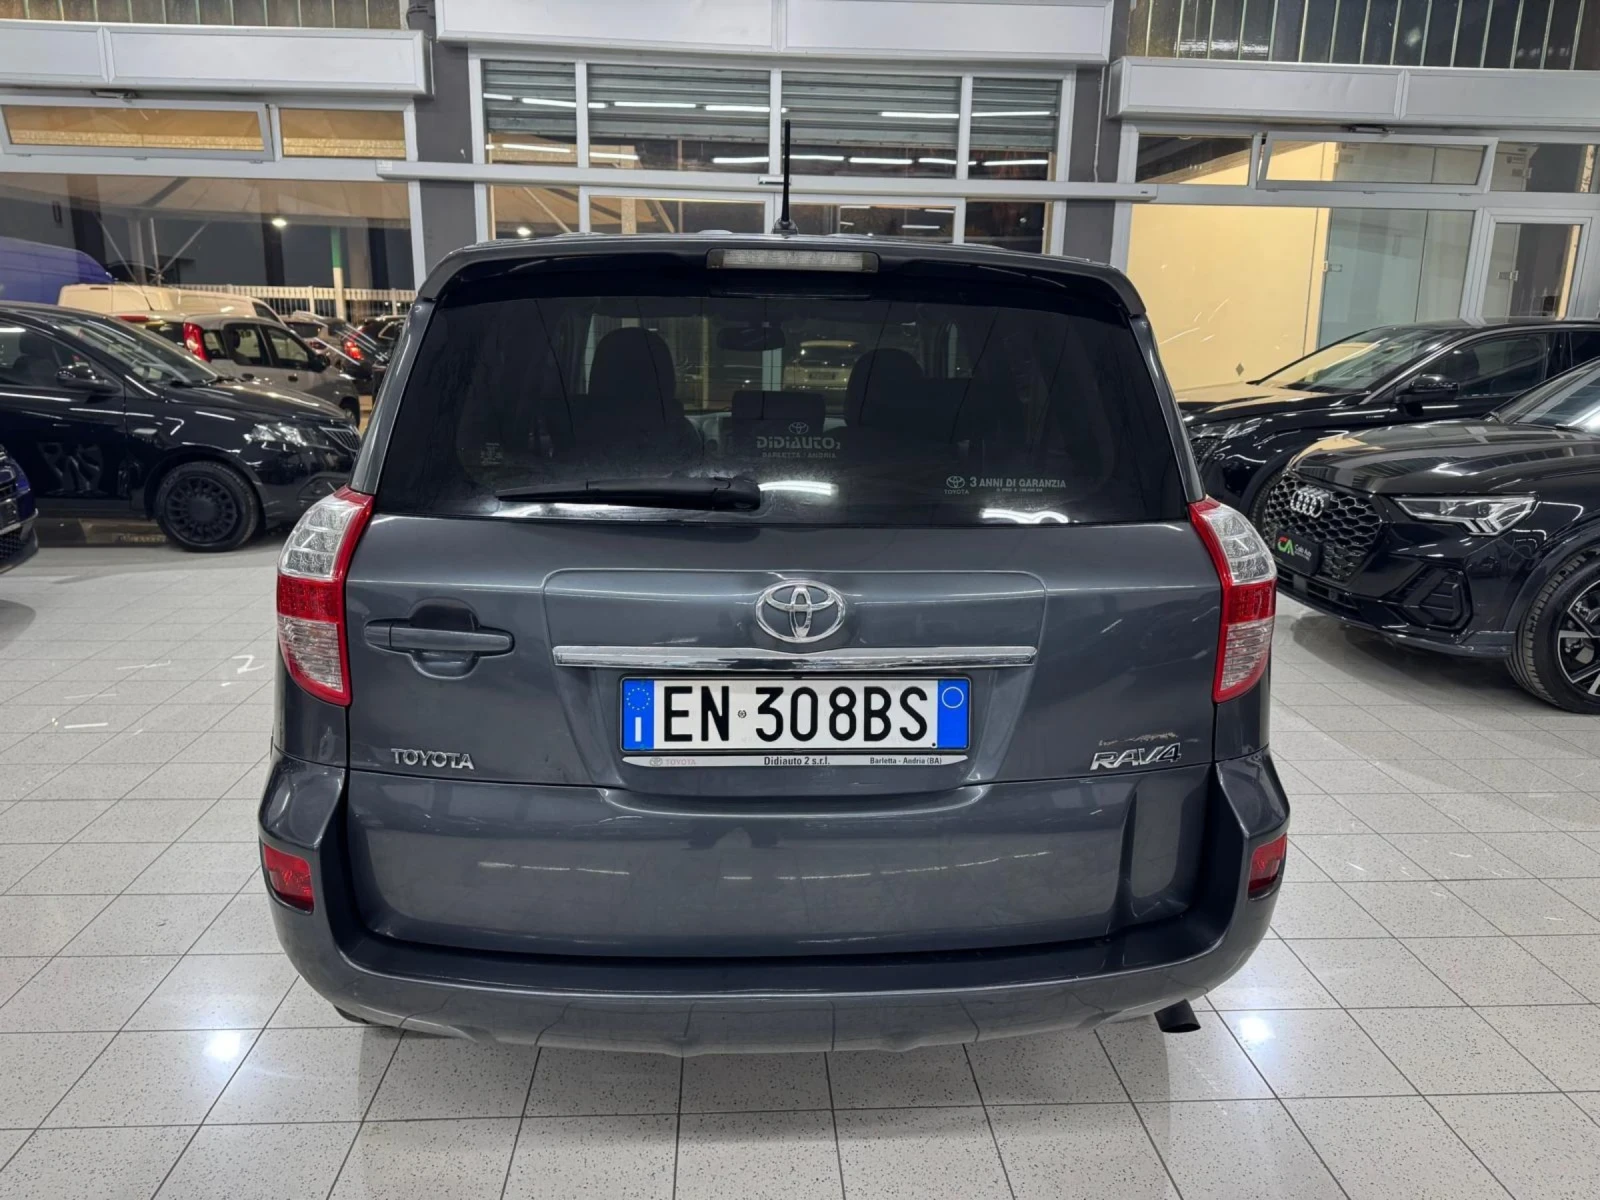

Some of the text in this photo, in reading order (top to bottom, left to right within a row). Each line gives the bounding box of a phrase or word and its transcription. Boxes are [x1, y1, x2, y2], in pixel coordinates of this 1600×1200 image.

[969, 476, 1067, 488] 3 ANNI DI GARANZIA
[664, 686, 928, 742] EN 308BS
[635, 717, 641, 741] I
[391, 748, 474, 769] TOYOTA
[763, 756, 831, 765] Didiauto 2 s.r.l.
[1090, 742, 1182, 770] RAV4
